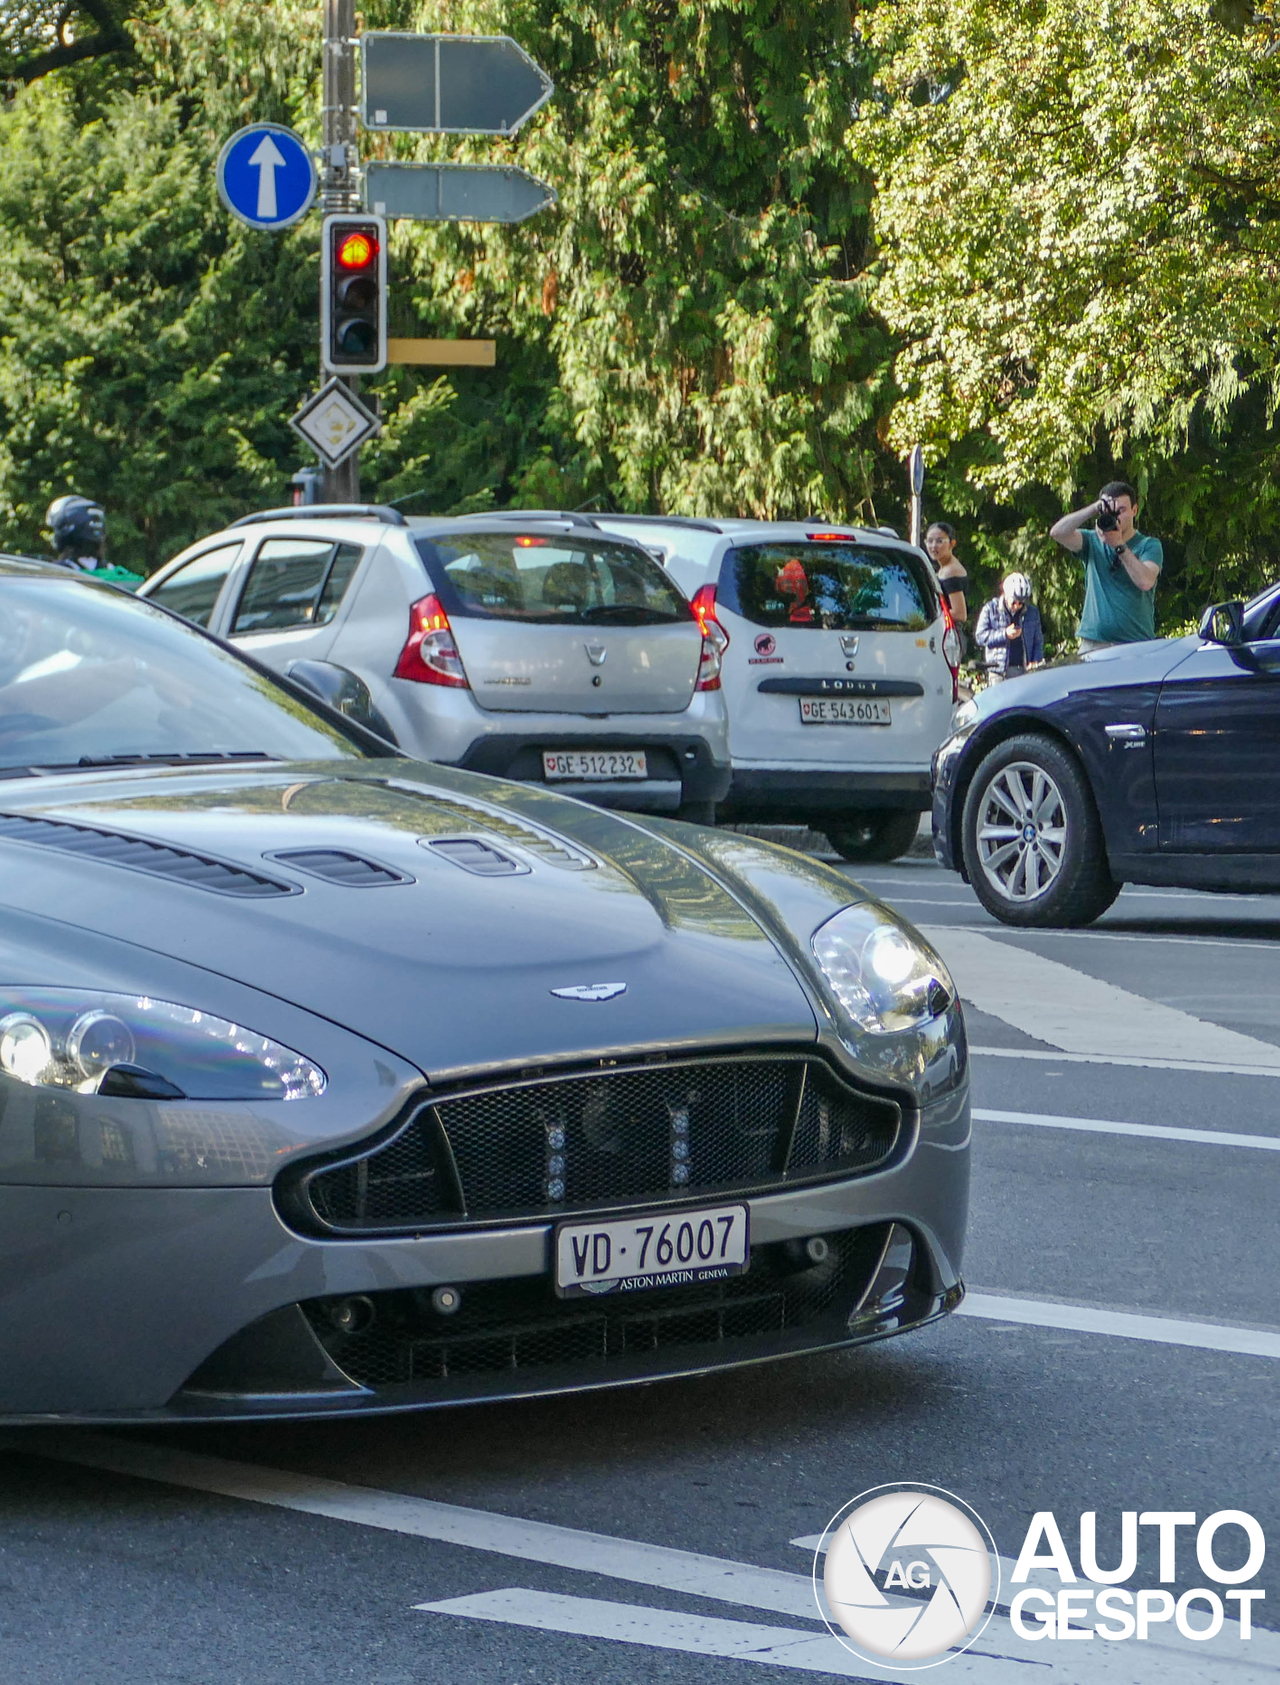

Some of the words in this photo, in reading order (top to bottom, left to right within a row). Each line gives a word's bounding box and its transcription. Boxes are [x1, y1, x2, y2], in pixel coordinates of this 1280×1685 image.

[620, 1274, 655, 1291] ASTON
[655, 1269, 694, 1287] MARTIN
[698, 1268, 729, 1281] GENEVA
